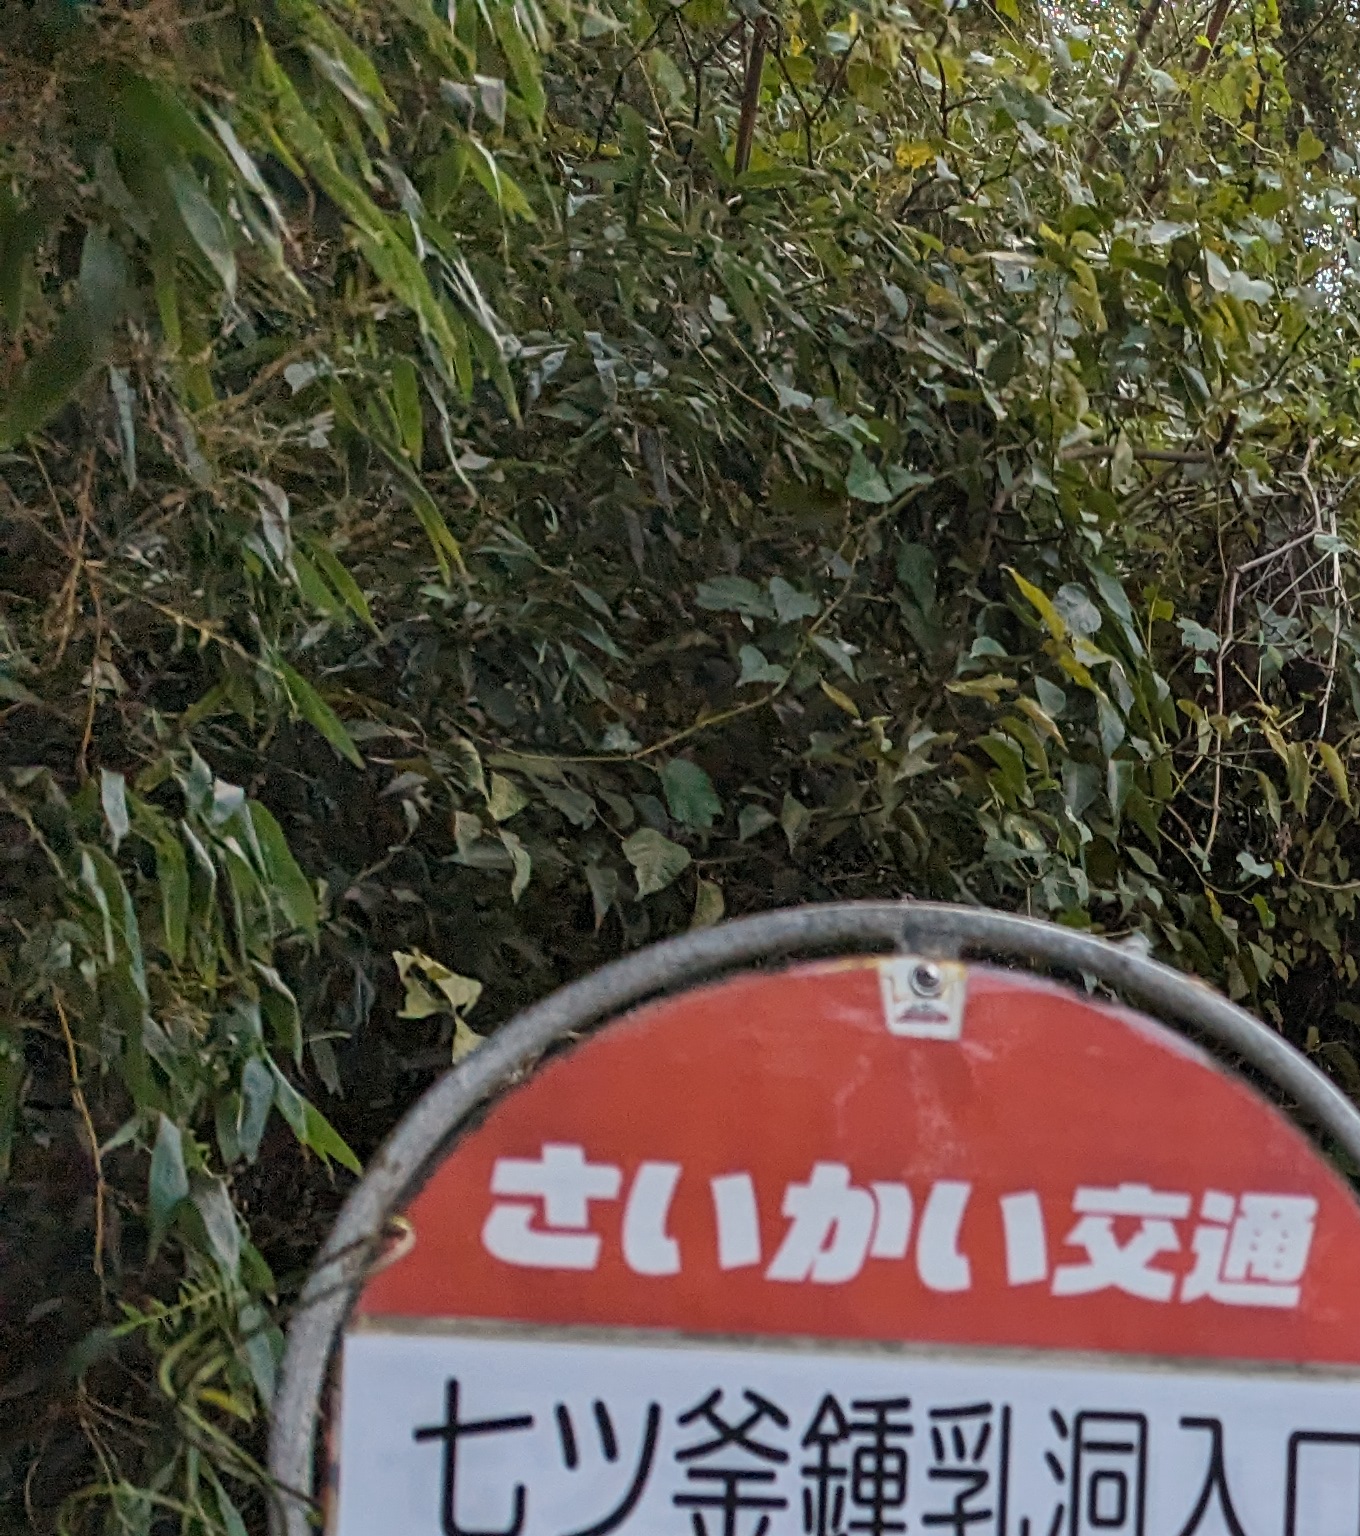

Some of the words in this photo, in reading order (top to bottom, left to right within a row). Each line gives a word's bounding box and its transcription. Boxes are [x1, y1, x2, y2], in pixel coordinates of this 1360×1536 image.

[481, 1142, 1320, 1308] さいかい交通
